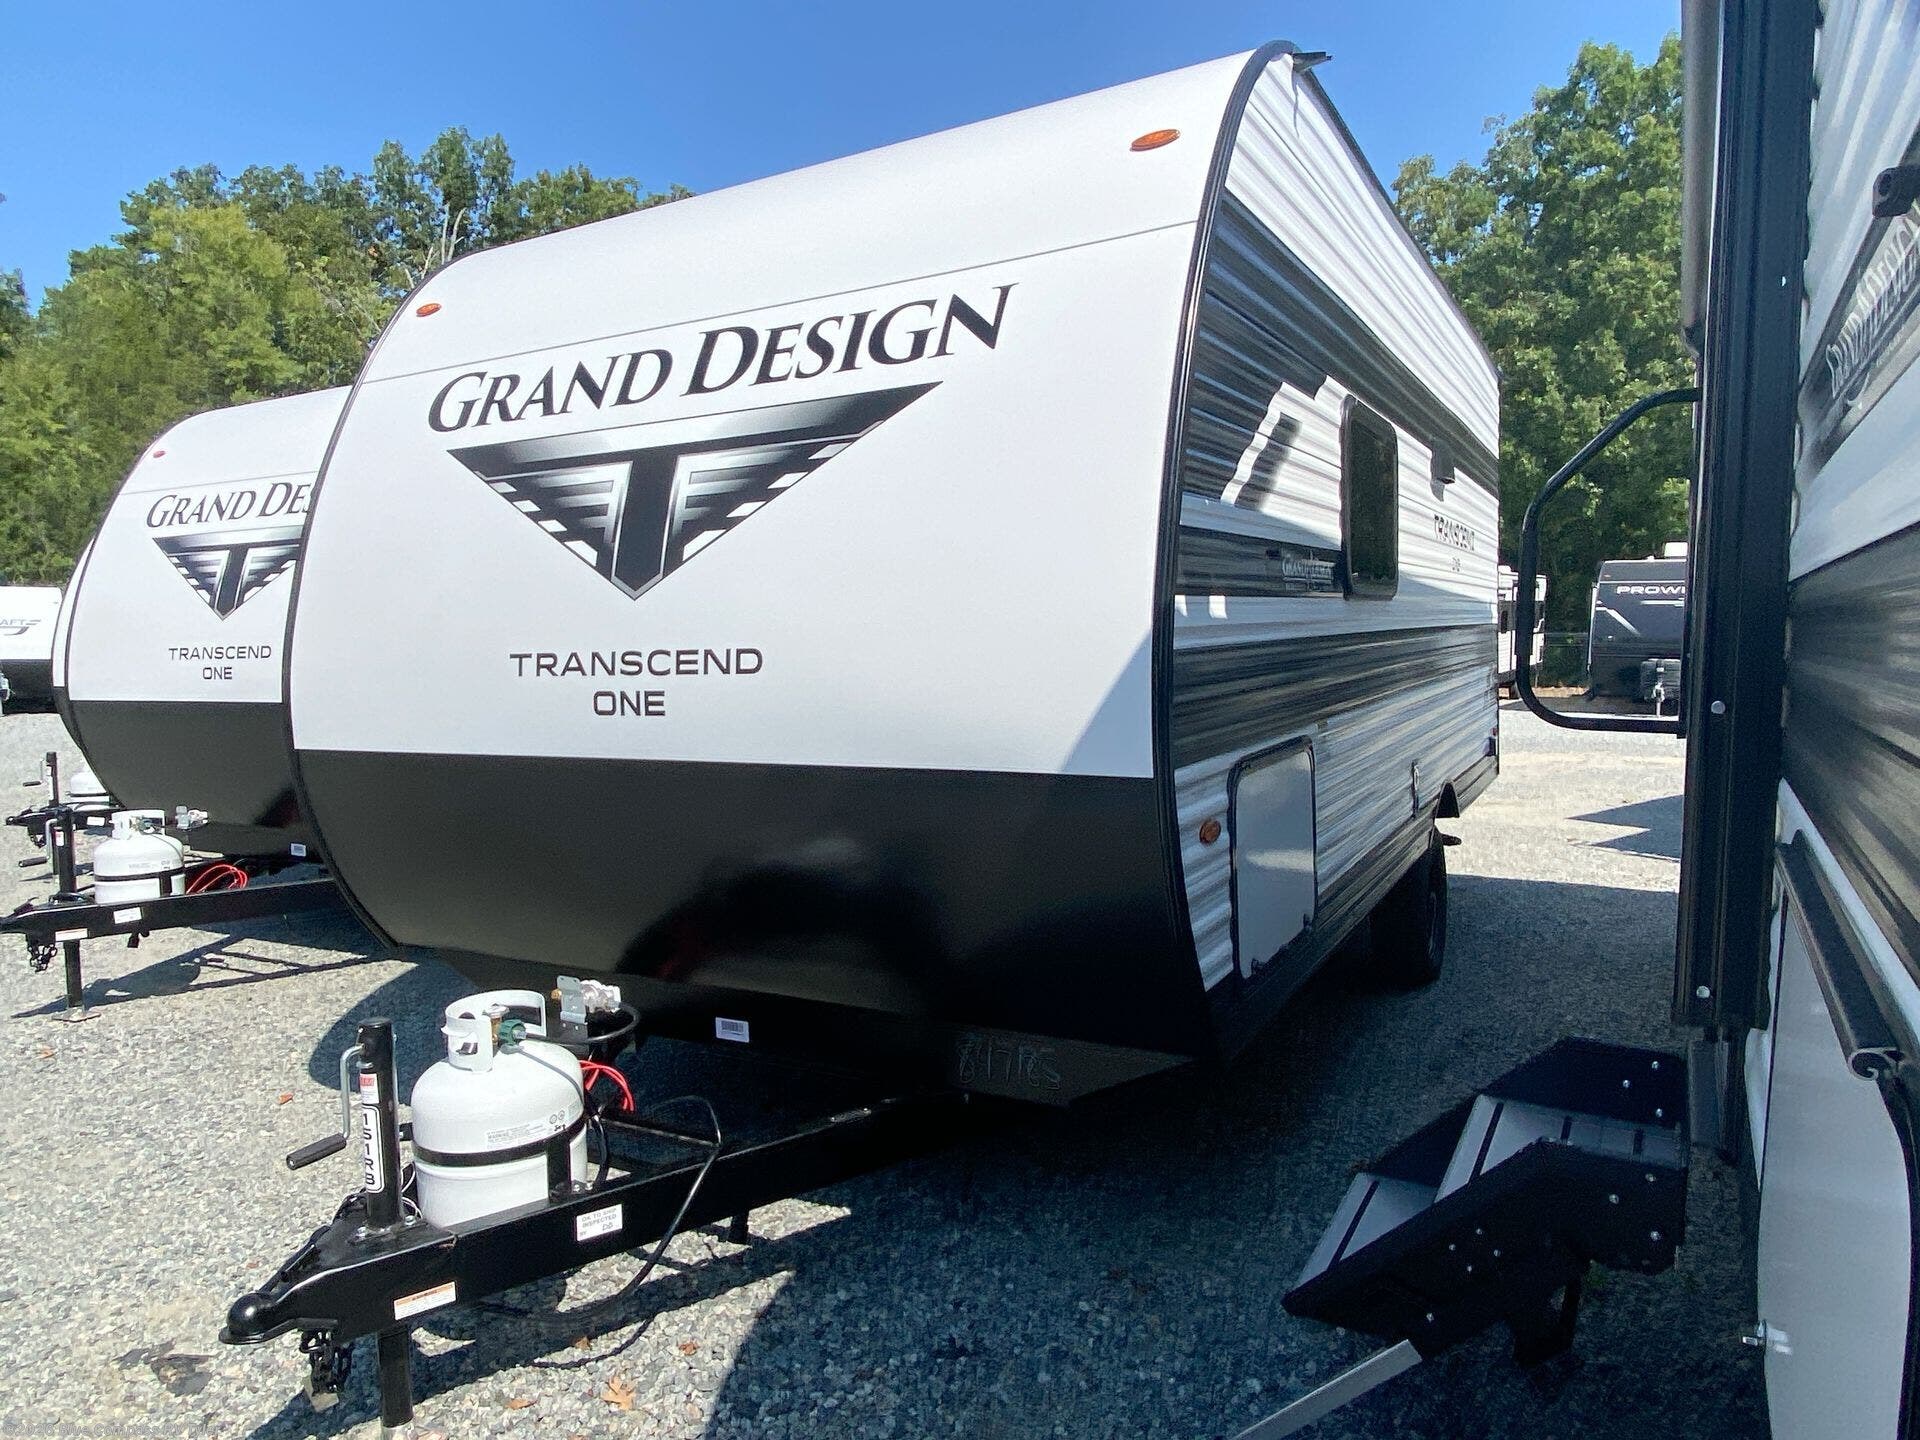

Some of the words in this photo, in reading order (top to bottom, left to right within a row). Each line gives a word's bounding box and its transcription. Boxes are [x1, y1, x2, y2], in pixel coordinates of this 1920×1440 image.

[427, 348, 674, 433] GRAND
[680, 282, 1020, 397] DESIGN
[146, 490, 257, 528] GRAND
[168, 645, 272, 661] TRANSCEND
[510, 647, 764, 678] TRANSCEND
[202, 666, 233, 680] ONE
[592, 689, 666, 717] ONE
